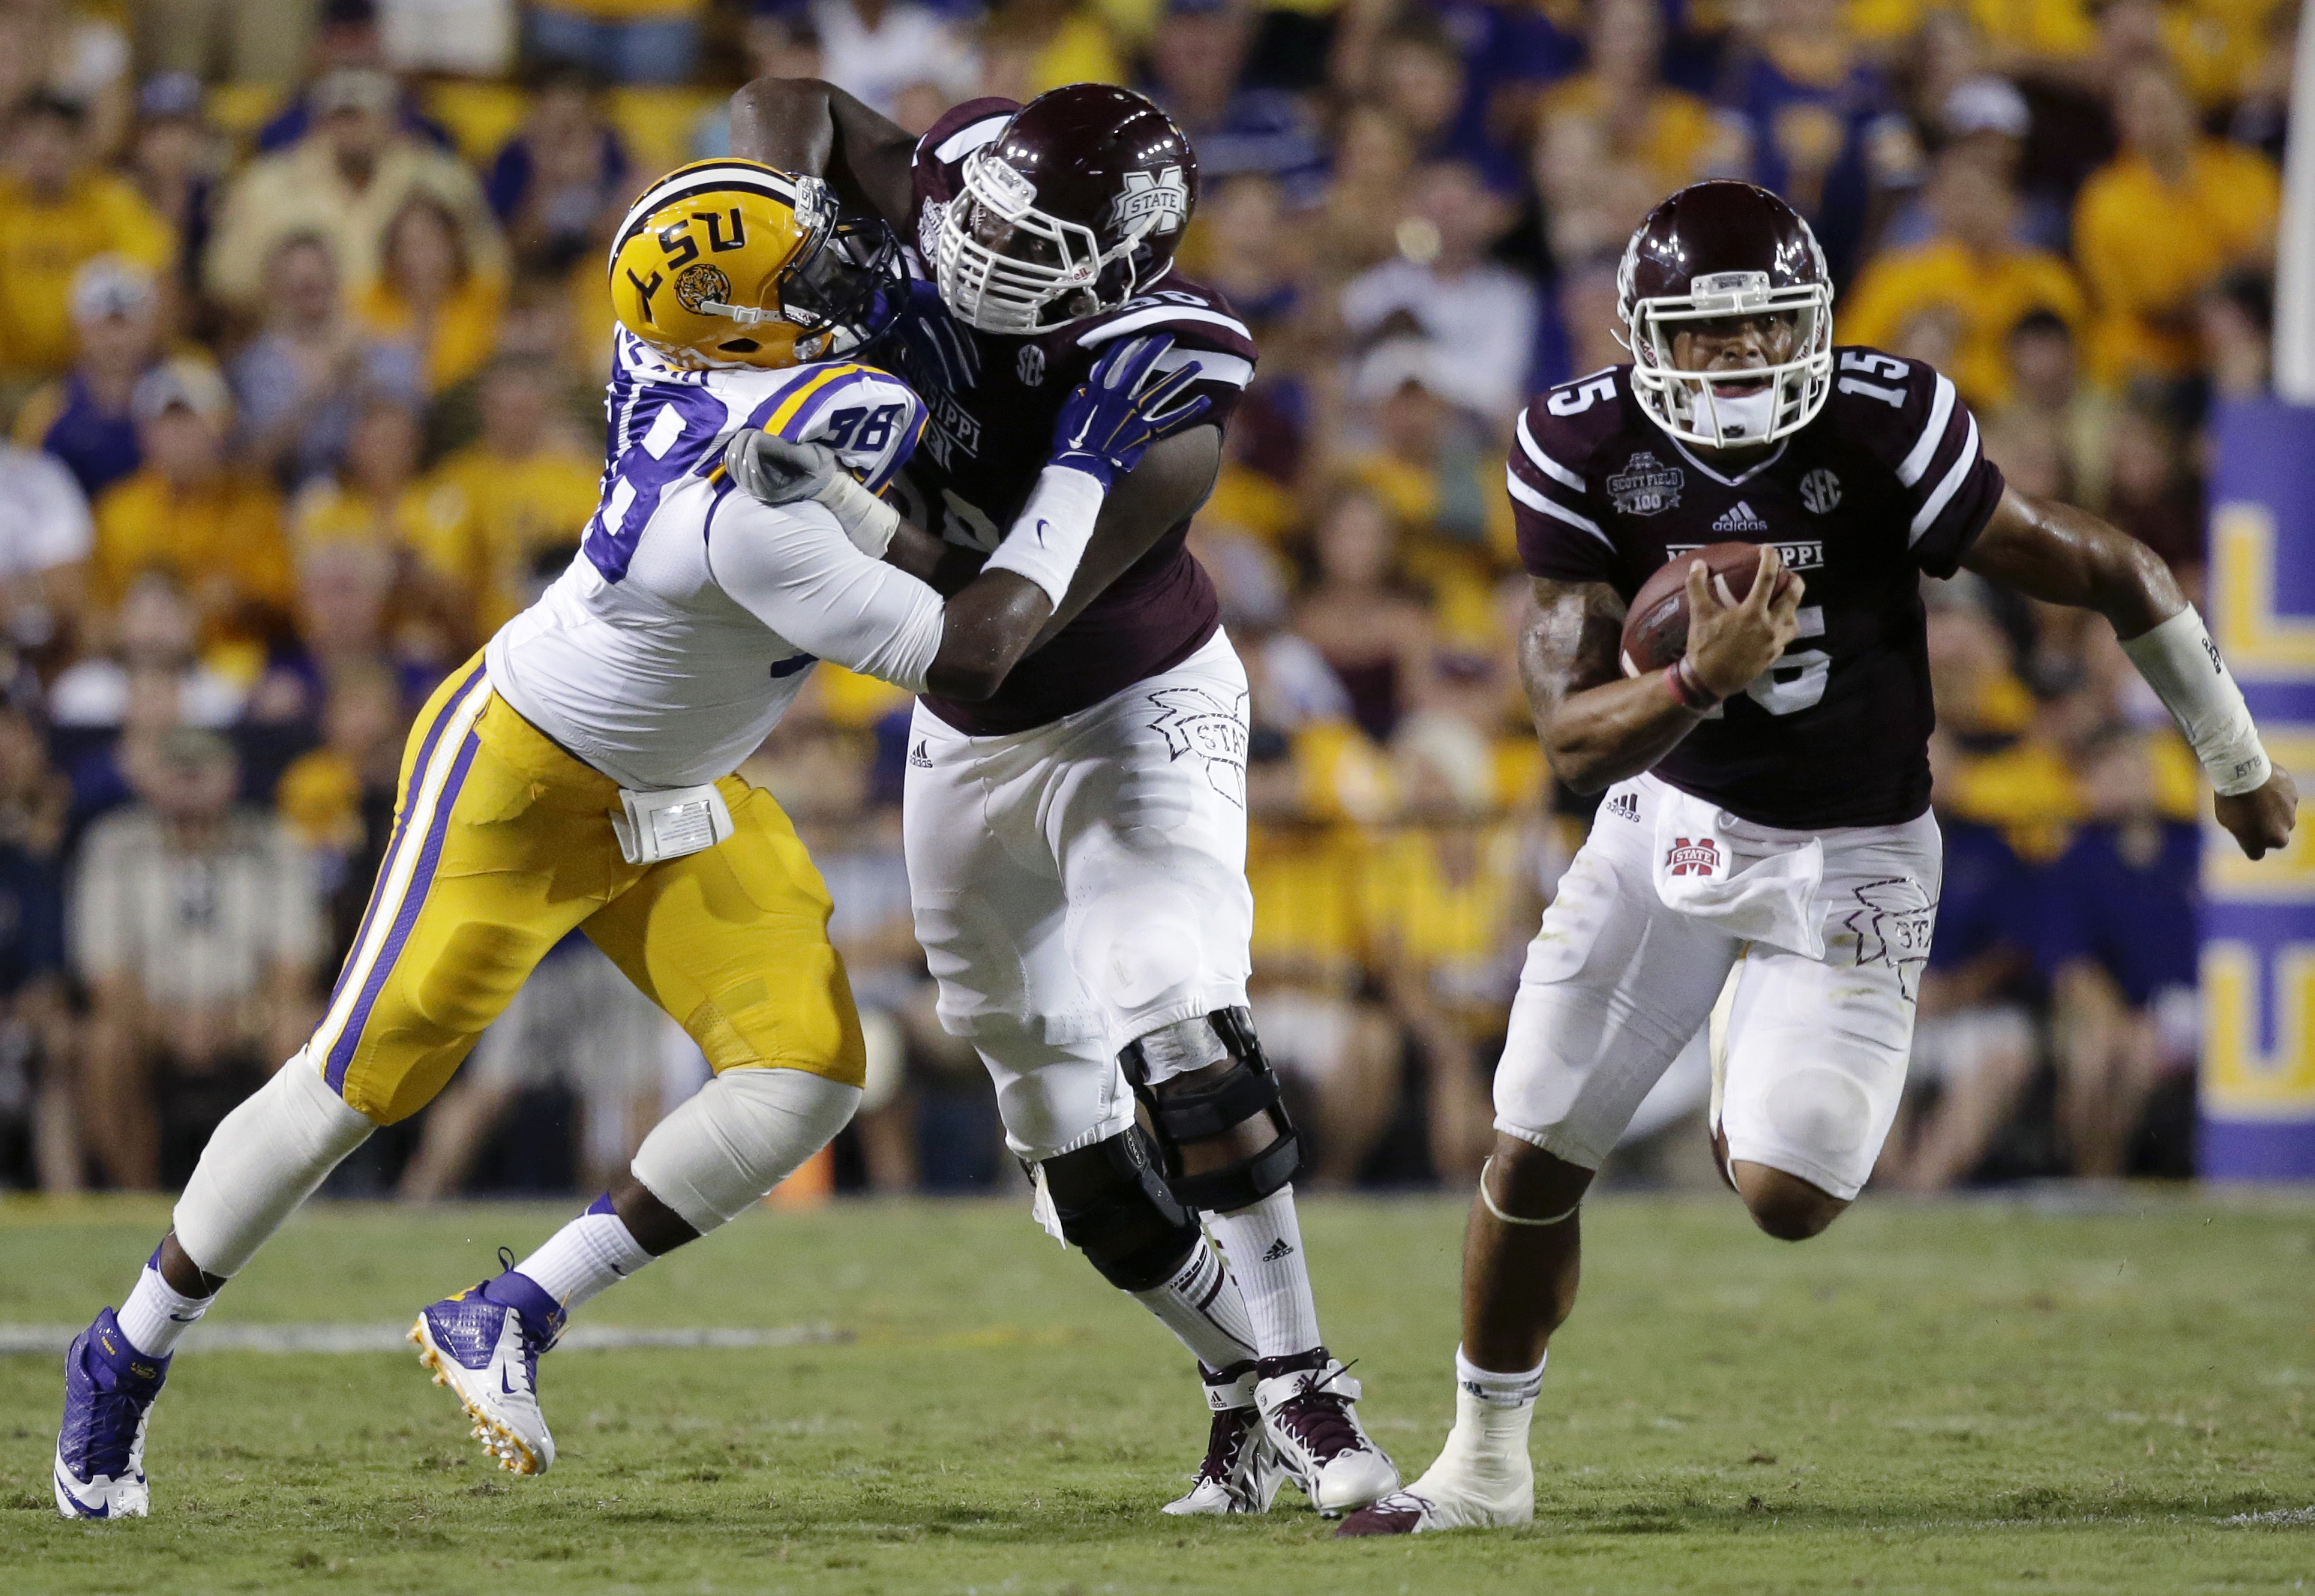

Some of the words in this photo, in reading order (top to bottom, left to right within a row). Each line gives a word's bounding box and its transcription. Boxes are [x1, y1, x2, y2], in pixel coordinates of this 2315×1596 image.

[1131, 193, 1177, 213] STATE
[626, 208, 745, 300] LSU
[1017, 344, 1045, 387] SEC
[1838, 351, 1910, 408] 15
[825, 404, 906, 452] 98
[1612, 476, 1645, 492] SCOTT
[1646, 472, 1678, 488] FIELD
[1800, 469, 1842, 514] SEC
[1635, 494, 1662, 511] 100
[1712, 519, 1768, 532] adidas
[1197, 724, 1246, 762] STAT
[1606, 802, 1642, 823] adidas
[1676, 849, 1712, 863] STATE
[1262, 1246, 1294, 1262] adidas
